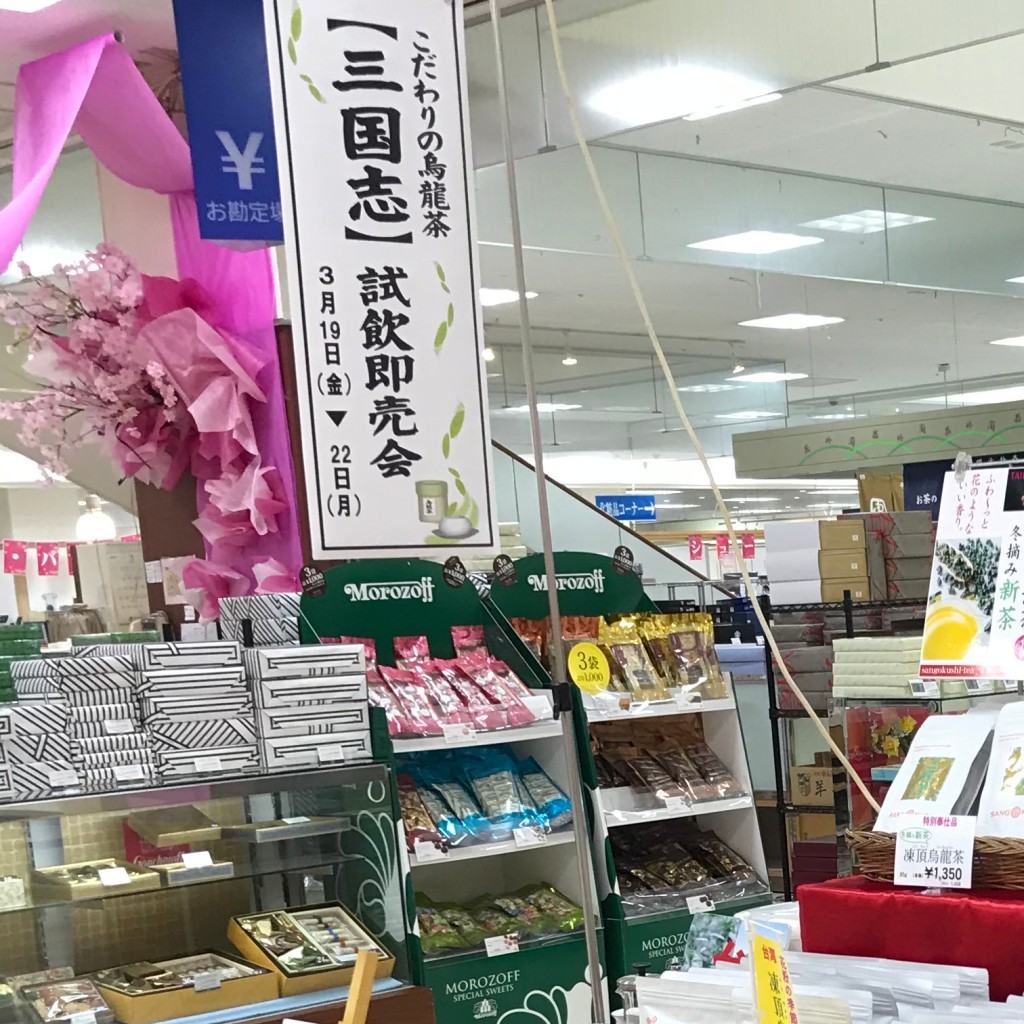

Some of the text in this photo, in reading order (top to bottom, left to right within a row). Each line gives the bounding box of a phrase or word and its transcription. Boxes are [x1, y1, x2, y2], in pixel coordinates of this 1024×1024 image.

[411, 30, 452, 239] こだわりの烏龍茶
[965, 473, 981, 535] 花のような
[343, 576, 435, 603] Morozoff
[527, 568, 606, 593] Mrozoff
[577, 651, 600, 671] 3袋
[904, 848, 965, 864] 凍頂烏龍茶
[925, 867, 962, 881] ¥1,350
[648, 946, 678, 959] SPECIAL
[446, 970, 521, 994] MOROZOFF
[453, 984, 514, 1003] SPECIAL SWEETS
